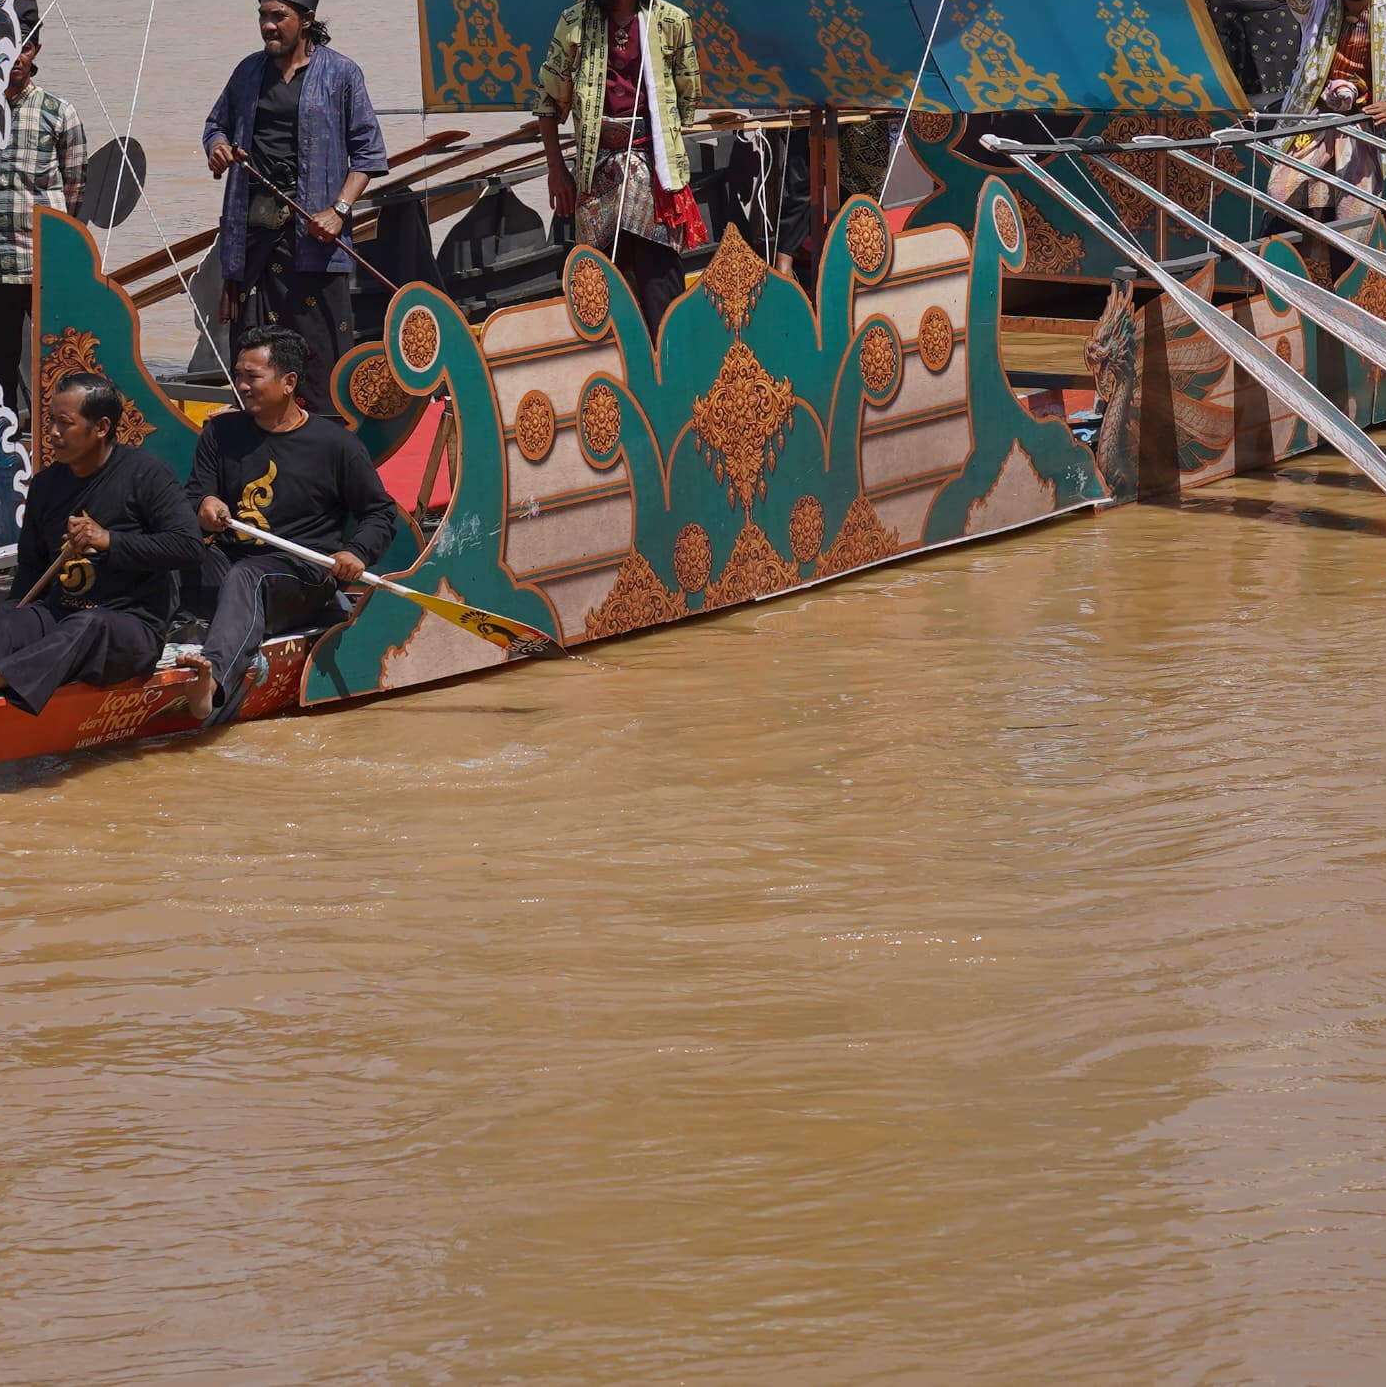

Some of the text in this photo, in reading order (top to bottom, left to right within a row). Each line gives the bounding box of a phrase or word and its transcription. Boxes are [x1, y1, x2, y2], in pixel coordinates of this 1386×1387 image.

[78, 704, 152, 734] dari hati
[104, 727, 137, 742] SULTAN
